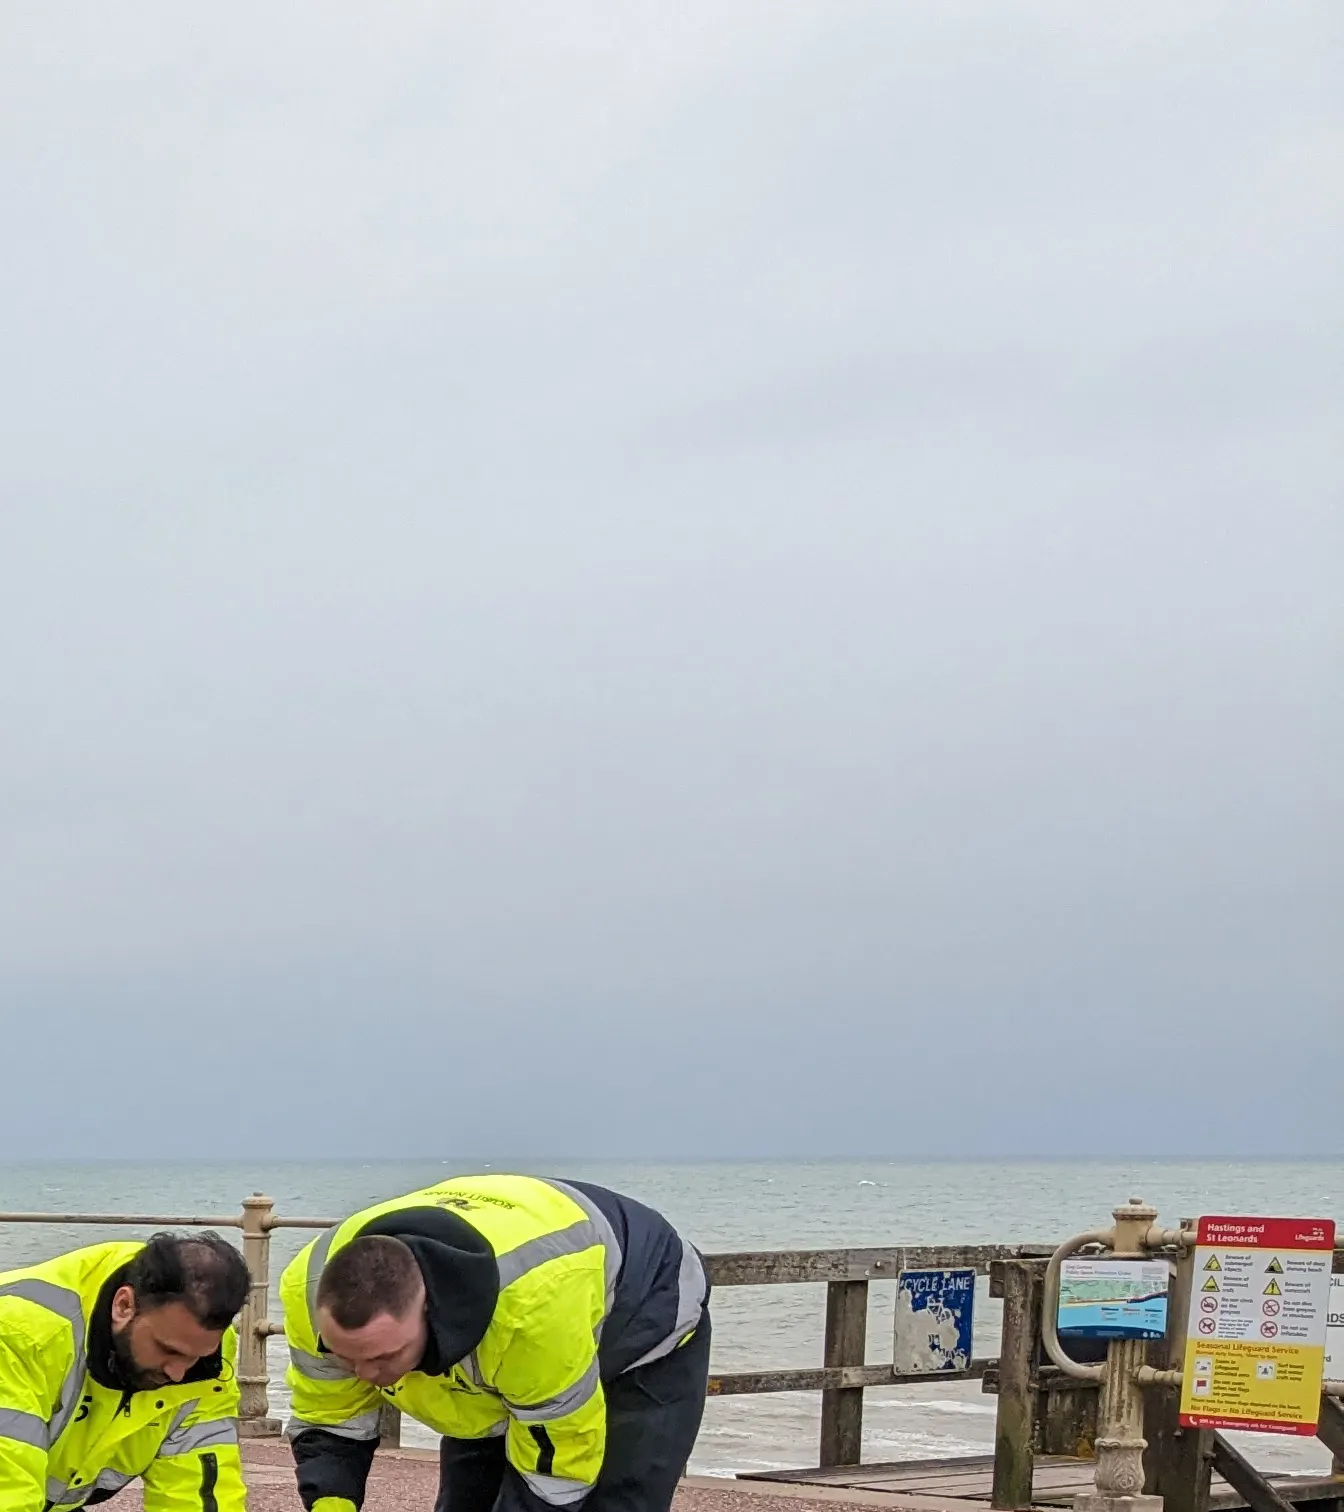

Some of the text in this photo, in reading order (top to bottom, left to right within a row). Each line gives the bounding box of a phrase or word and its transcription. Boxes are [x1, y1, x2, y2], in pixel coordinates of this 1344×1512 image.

[1208, 1224, 1265, 1234] Hastings and
[1207, 1234, 1258, 1243] St Leonards
[905, 1277, 970, 1292] CYCLE LANE
[1197, 1342, 1299, 1354] Seasonal Lifeguard Service
[1242, 1409, 1275, 1417] Lifeguard
[1278, 1411, 1302, 1419] Service
